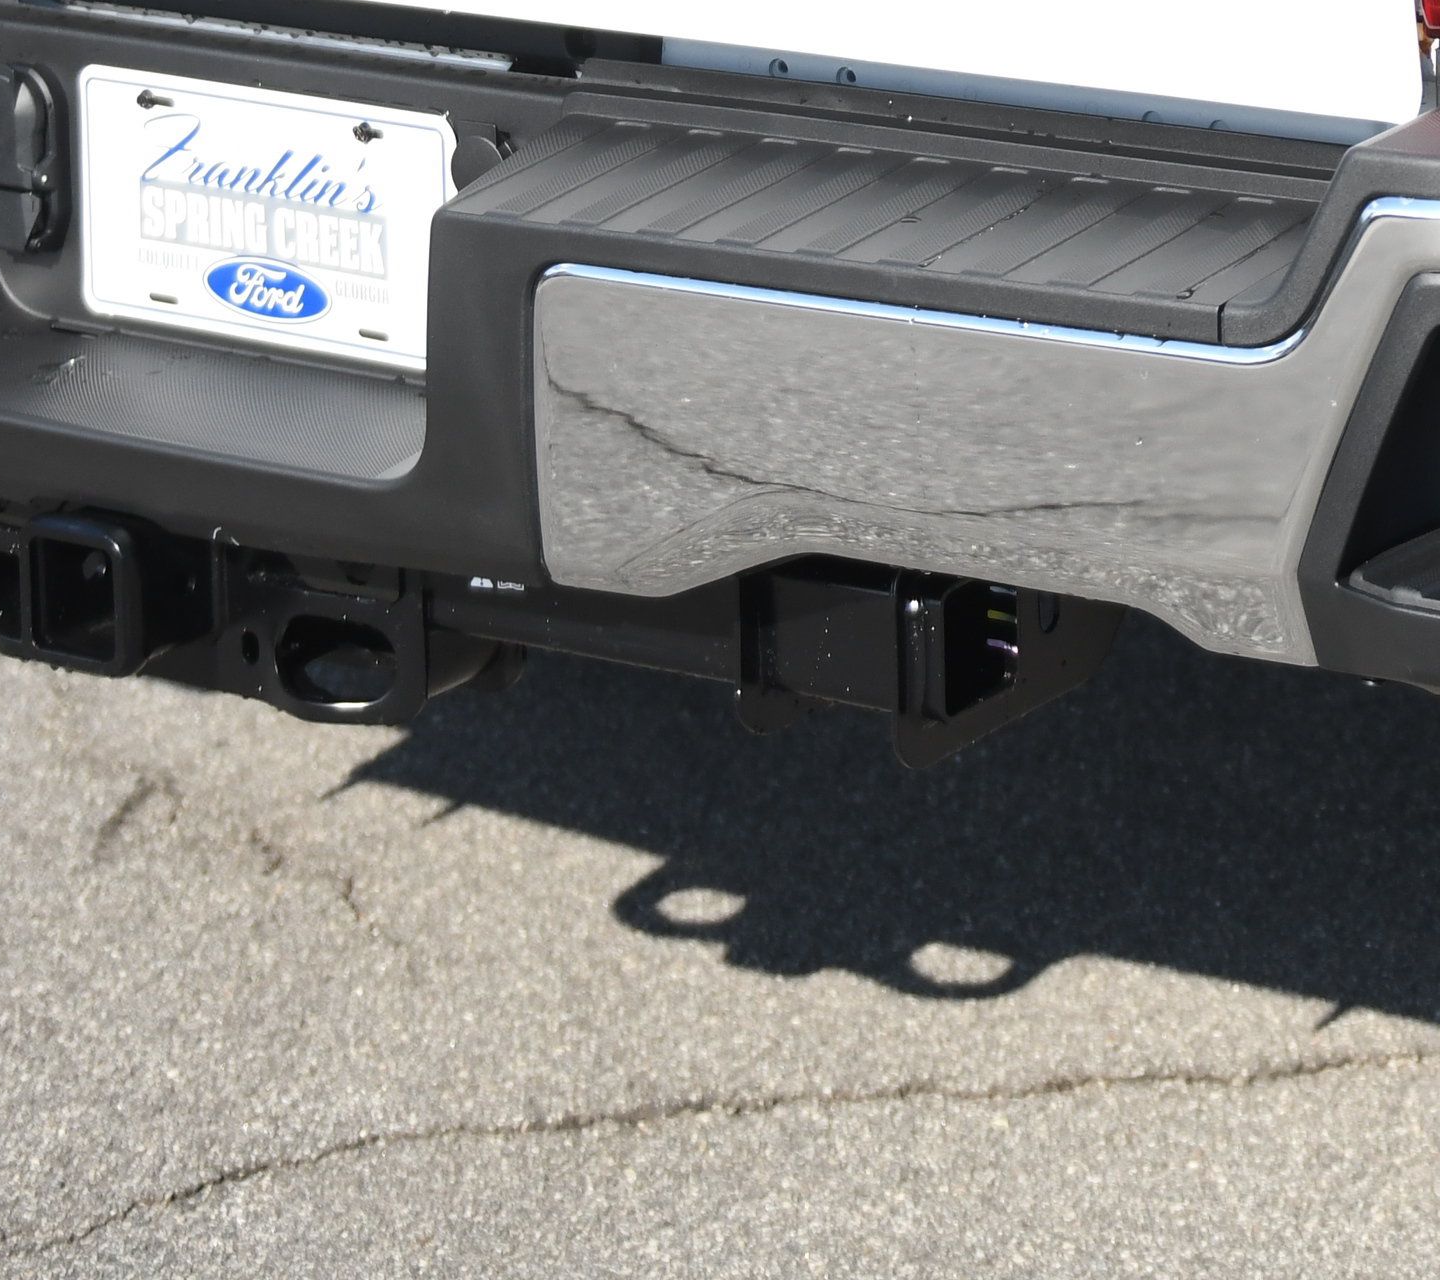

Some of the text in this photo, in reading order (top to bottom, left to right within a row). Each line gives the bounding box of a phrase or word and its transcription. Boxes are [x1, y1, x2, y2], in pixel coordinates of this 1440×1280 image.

[140, 112, 385, 214] Franklin's
[141, 183, 387, 276] SPRING CREEK
[229, 262, 306, 314] Ford
